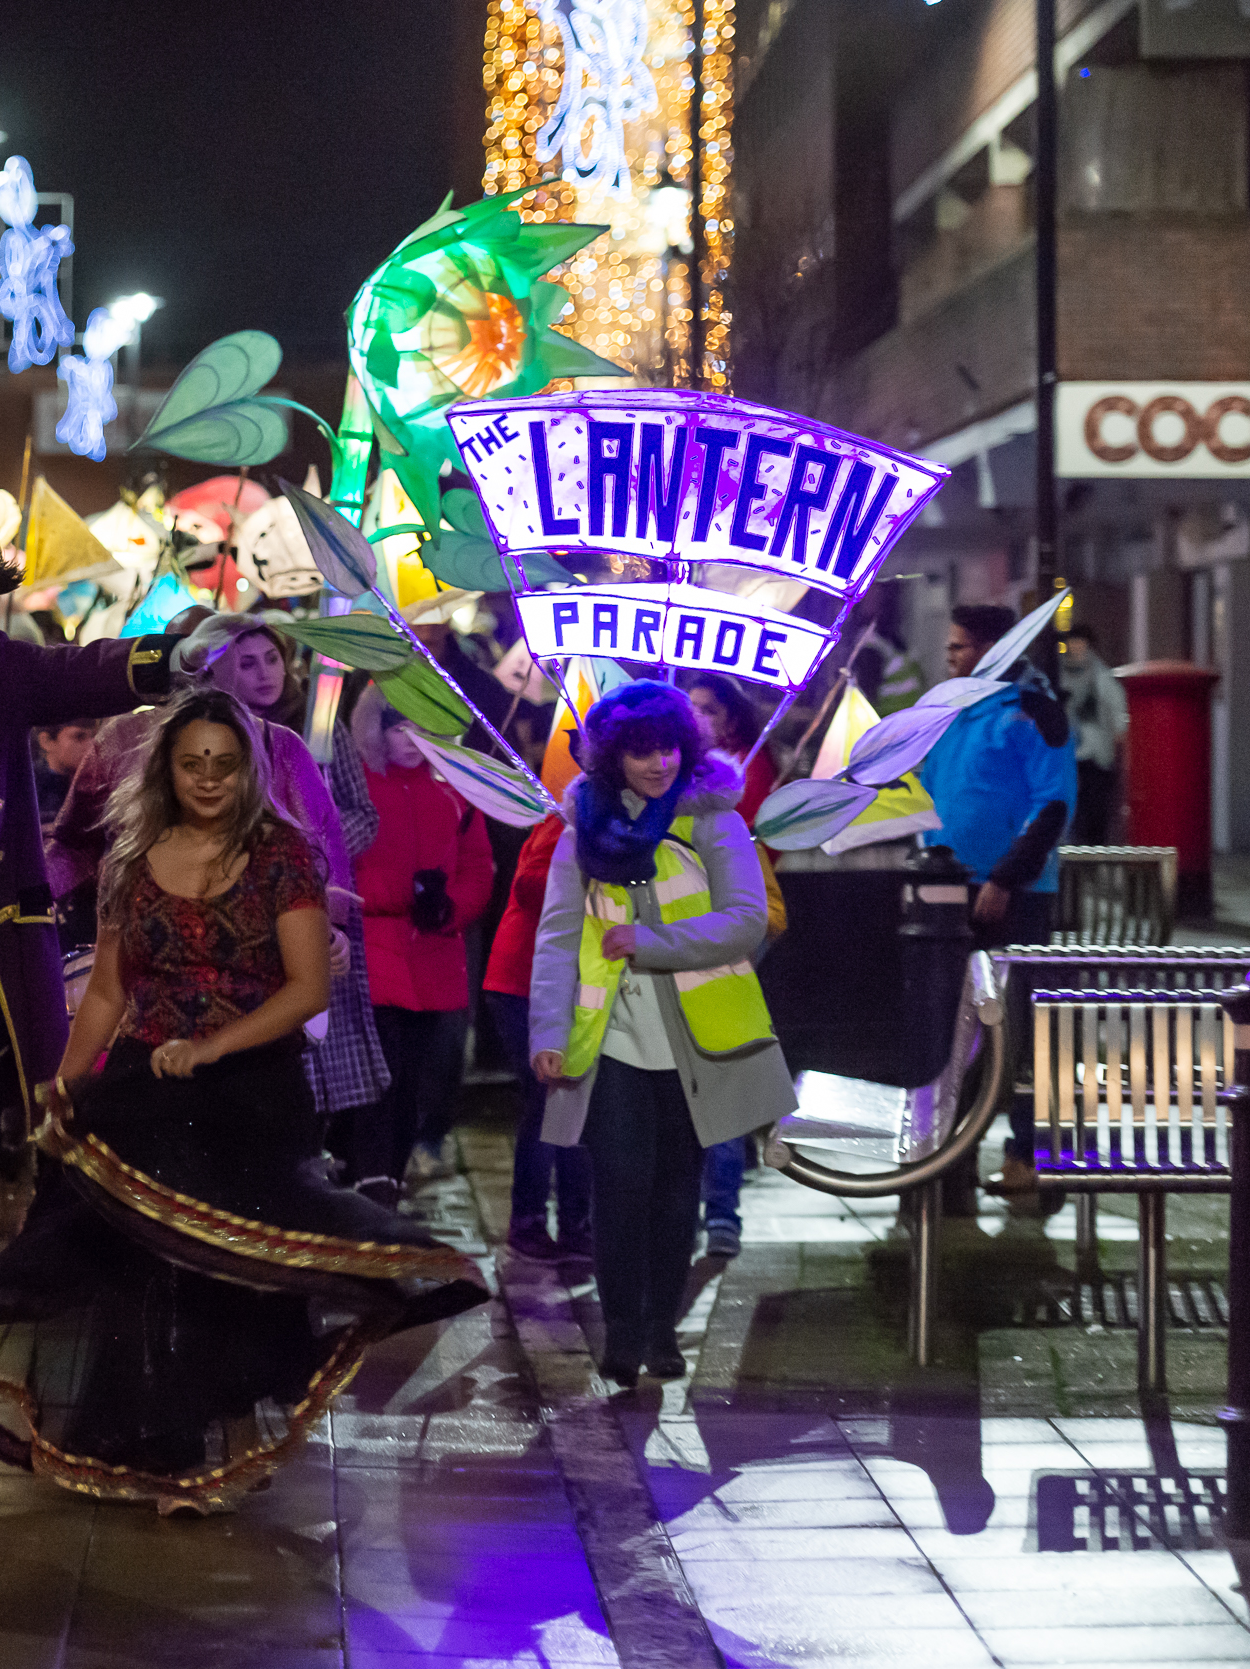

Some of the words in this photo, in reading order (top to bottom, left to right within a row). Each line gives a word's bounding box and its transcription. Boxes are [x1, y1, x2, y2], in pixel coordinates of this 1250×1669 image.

[459, 413, 519, 464] THE
[528, 420, 899, 581] LANTERN
[552, 602, 788, 676] PARADE
